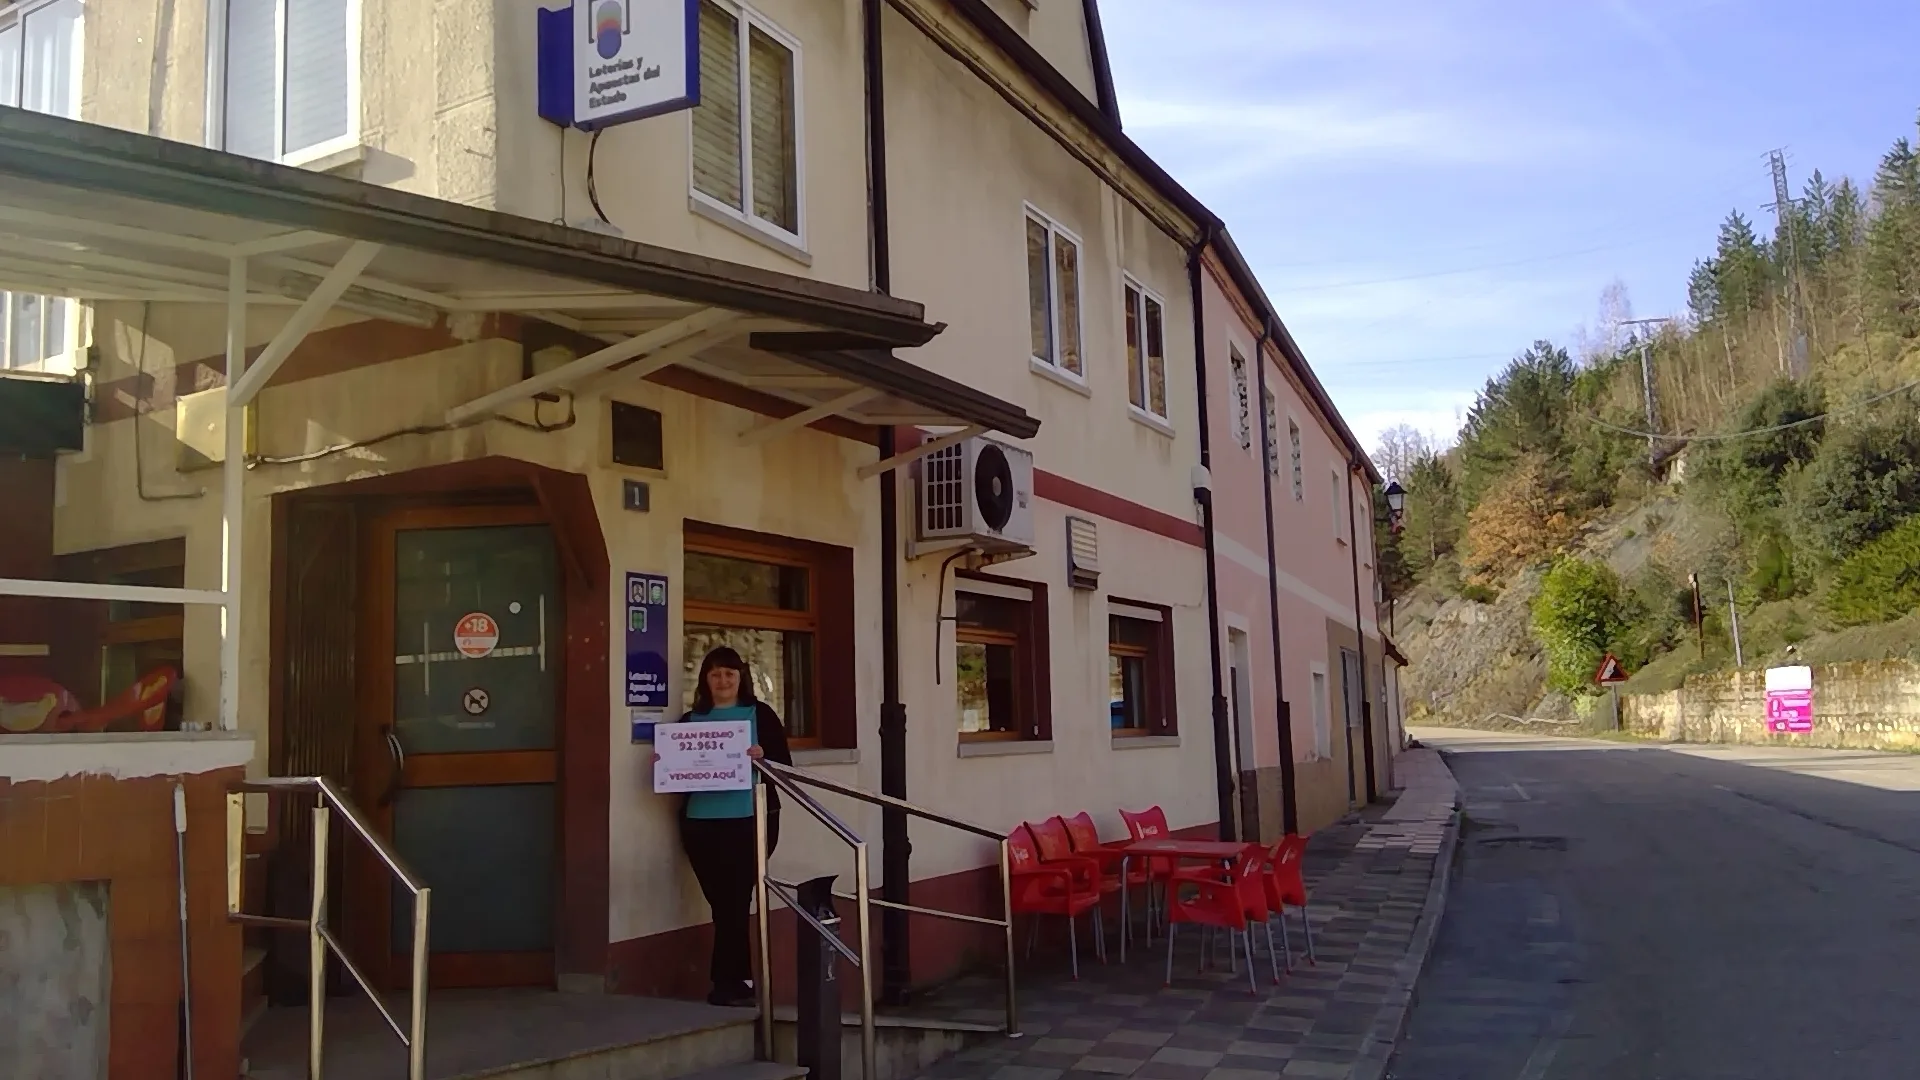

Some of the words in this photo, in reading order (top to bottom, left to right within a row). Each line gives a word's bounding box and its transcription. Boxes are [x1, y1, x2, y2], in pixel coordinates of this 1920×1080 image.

[636, 56, 643, 71] y
[671, 732, 697, 740] GRAN
[699, 730, 735, 739] PREMIO
[669, 771, 711, 780] VENDIDO
